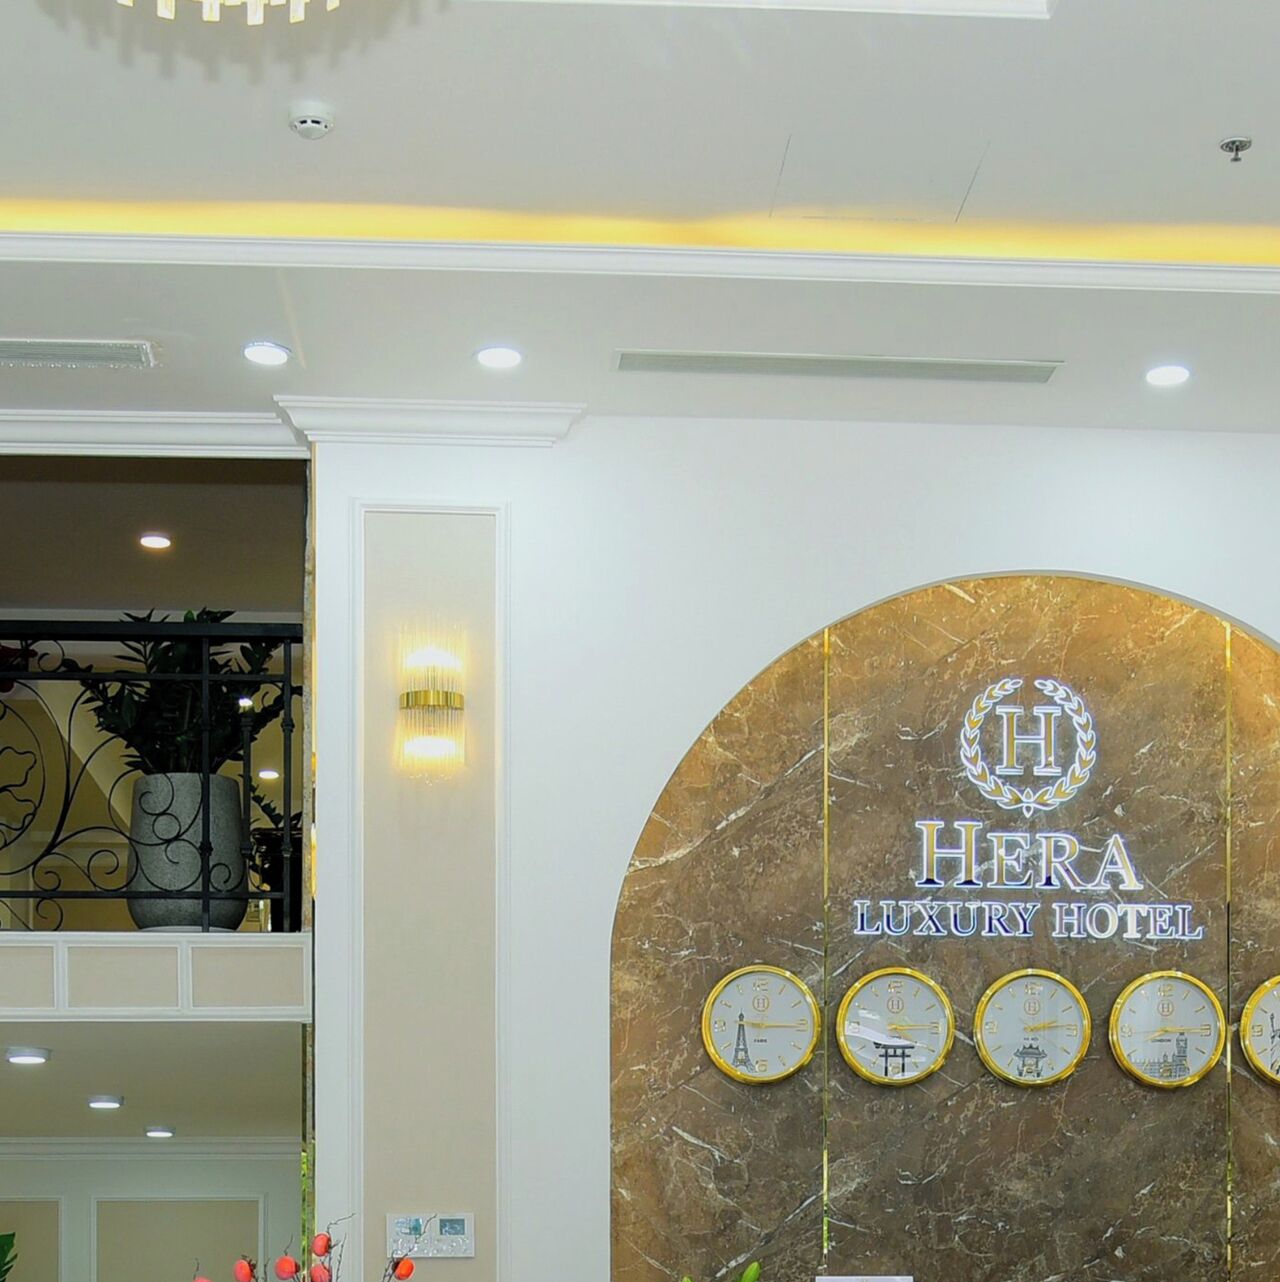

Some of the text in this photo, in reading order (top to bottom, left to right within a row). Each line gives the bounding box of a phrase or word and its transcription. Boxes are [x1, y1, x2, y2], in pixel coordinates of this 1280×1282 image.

[995, 705, 1062, 776] H
[915, 820, 1145, 891] HERA
[853, 899, 1204, 940] LUXURY HOTEL
